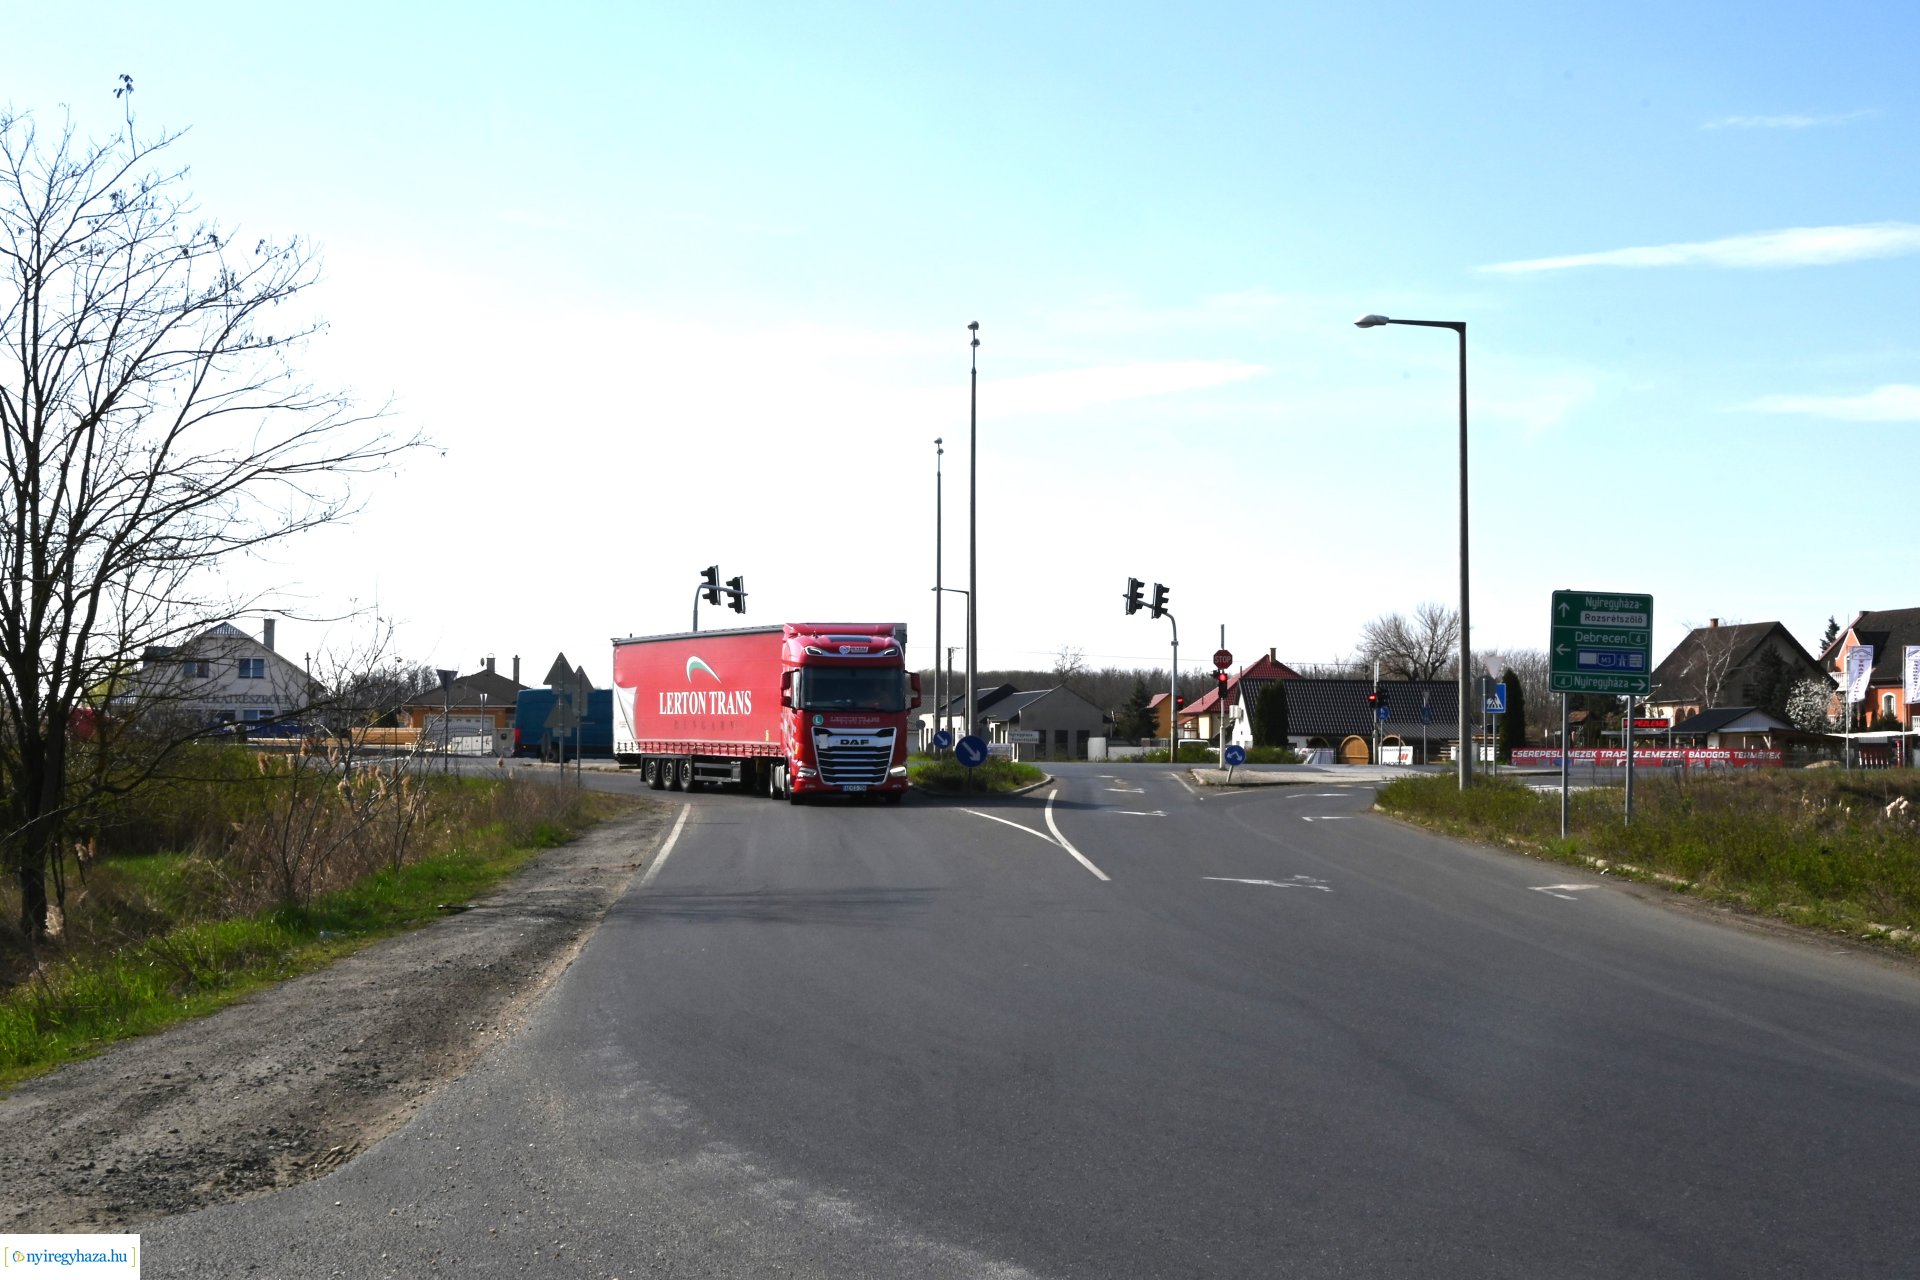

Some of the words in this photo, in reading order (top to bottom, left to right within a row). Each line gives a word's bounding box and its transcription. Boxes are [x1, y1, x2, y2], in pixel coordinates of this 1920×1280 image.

[1575, 631, 1627, 644] Debrecen
[1214, 655, 1232, 664] STOP
[1573, 675, 1629, 690] Nyíregyháza
[659, 692, 707, 716] LERTON
[709, 690, 752, 716] TRANS
[1511, 750, 1598, 758] CSEREPESLMEZEK
[1600, 750, 1686, 759] TRAPZLEMEZEK
[1688, 749, 1731, 759] BÁDOGOS
[1734, 749, 1781, 760] TERMÉKEK
